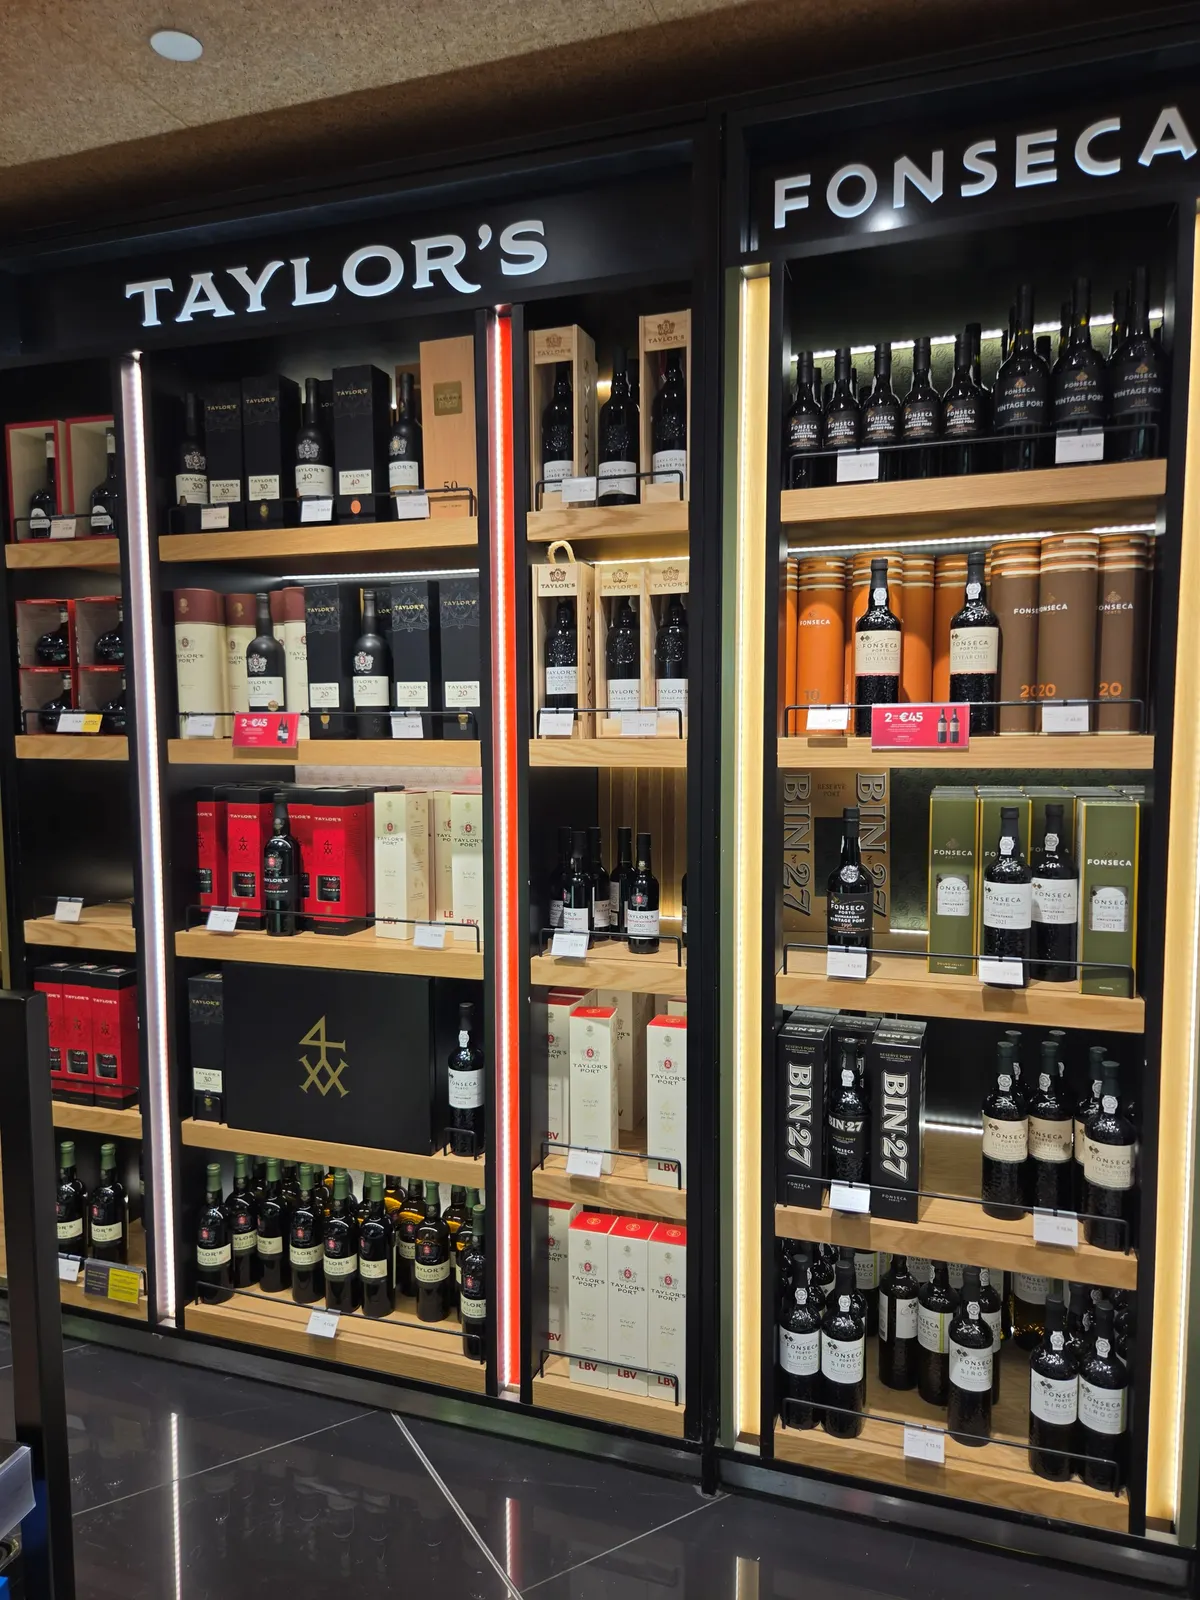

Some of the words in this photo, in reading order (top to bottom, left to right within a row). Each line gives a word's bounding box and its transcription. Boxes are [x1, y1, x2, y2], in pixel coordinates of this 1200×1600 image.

[774, 106, 1197, 229] FONSECA
[125, 220, 549, 327] TAYLOR'S
[648, 335, 685, 343] TAYLOR'S
[1065, 381, 1096, 389] FONSECA
[828, 421, 854, 429] FONSECA
[444, 481, 458, 492] 50
[1039, 684, 1056, 696] 20
[1099, 682, 1122, 696] 20
[241, 718, 247, 726] 2
[885, 713, 892, 722] 2
[900, 712, 923, 722] €45
[784, 773, 811, 853] BIN
[857, 772, 887, 853] BIN
[1087, 859, 1131, 867] FONSECA
[784, 863, 811, 916] 27
[788, 1063, 812, 1124] BIN
[883, 1072, 908, 1135] BIN
[829, 1115, 845, 1131] BIN
[847, 1121, 863, 1131] 27
[787, 1126, 812, 1169] 27
[881, 1137, 908, 1181] 27
[1092, 1155, 1130, 1164] FONSECA
[658, 1162, 678, 1172] LBV
[572, 1276, 605, 1284] TAYLOR'S
[611, 1282, 645, 1291] TAYLOR'S
[651, 1288, 686, 1298] TAYLOR'S
[579, 1361, 598, 1372] LBV
[960, 1358, 992, 1366] FONSECA
[618, 1369, 637, 1379] LBV
[658, 1376, 676, 1387] LBV
[1082, 1393, 1120, 1408] FONSECA
[1084, 1404, 1119, 1418] SIROCO
